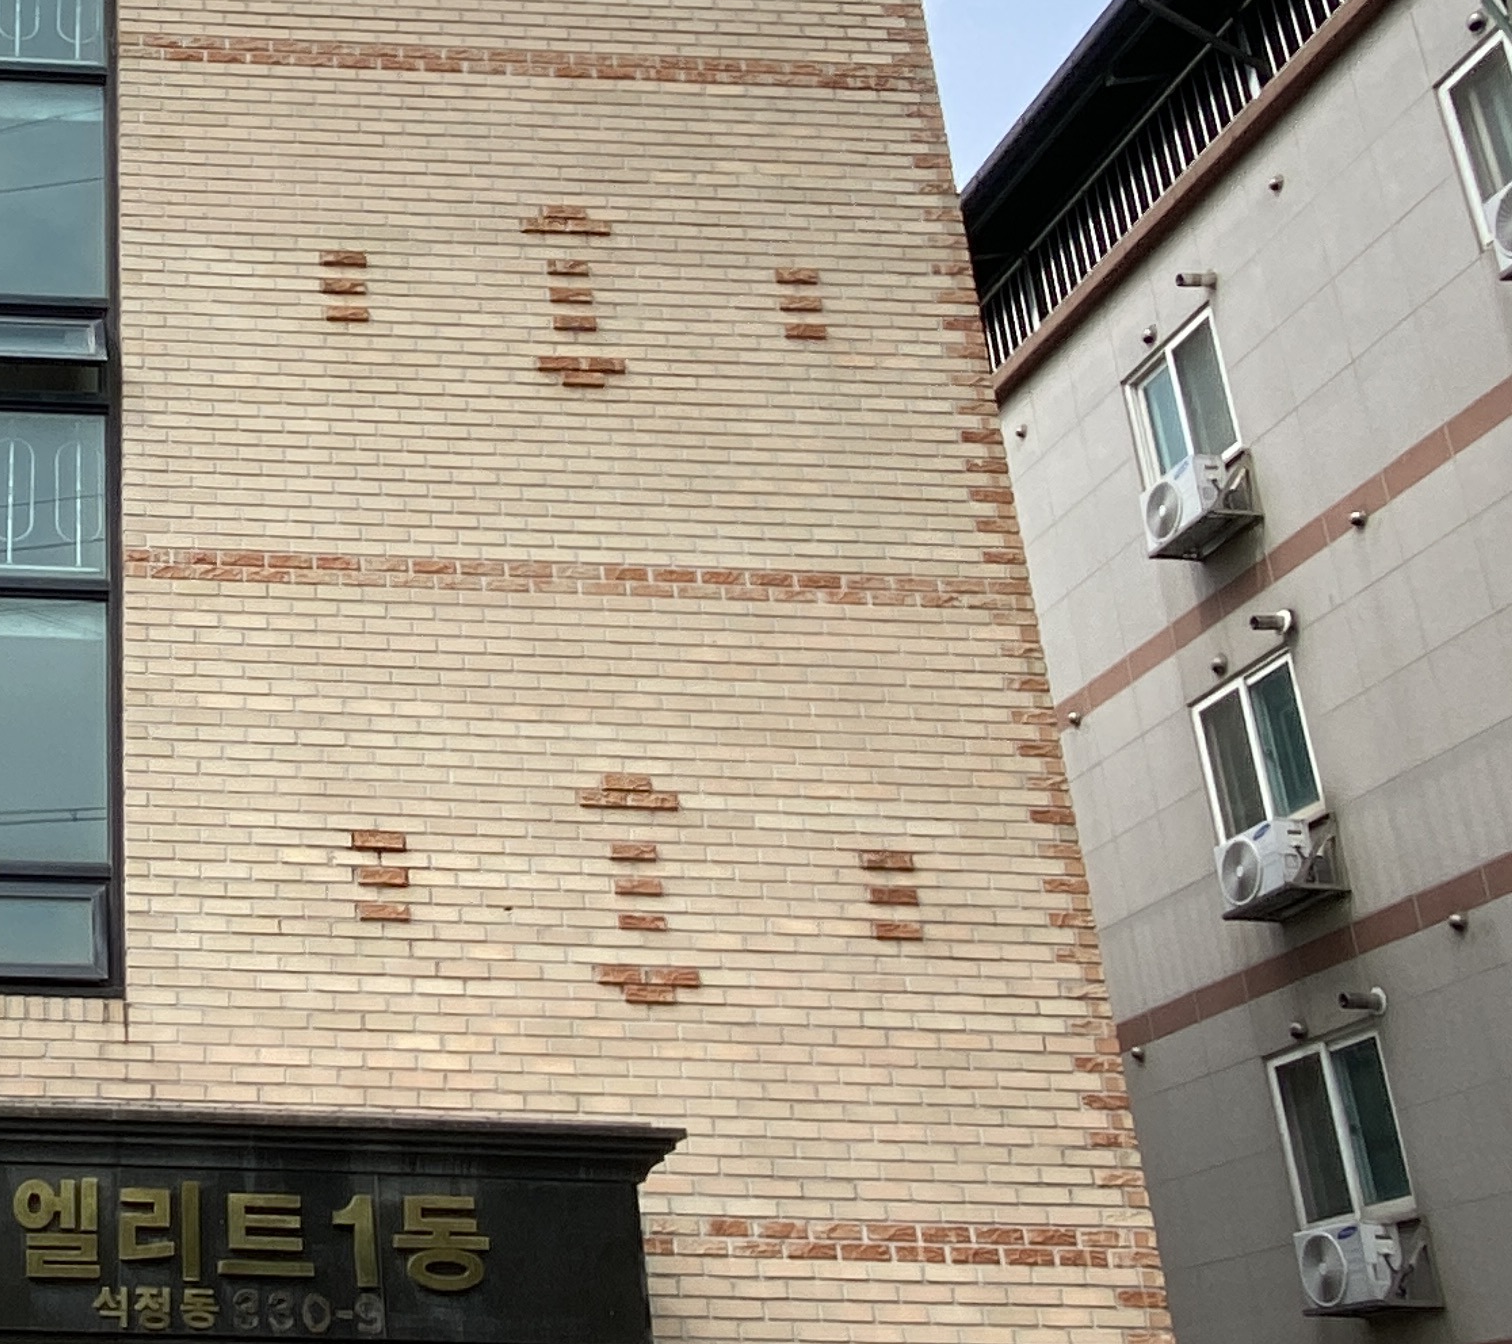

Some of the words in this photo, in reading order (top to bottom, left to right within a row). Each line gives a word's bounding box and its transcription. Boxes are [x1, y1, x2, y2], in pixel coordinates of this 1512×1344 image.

[12, 1177, 491, 1292] 엘리트1동
[92, 1286, 220, 1331] 석정동
[232, 1288, 383, 1335] 330-9
